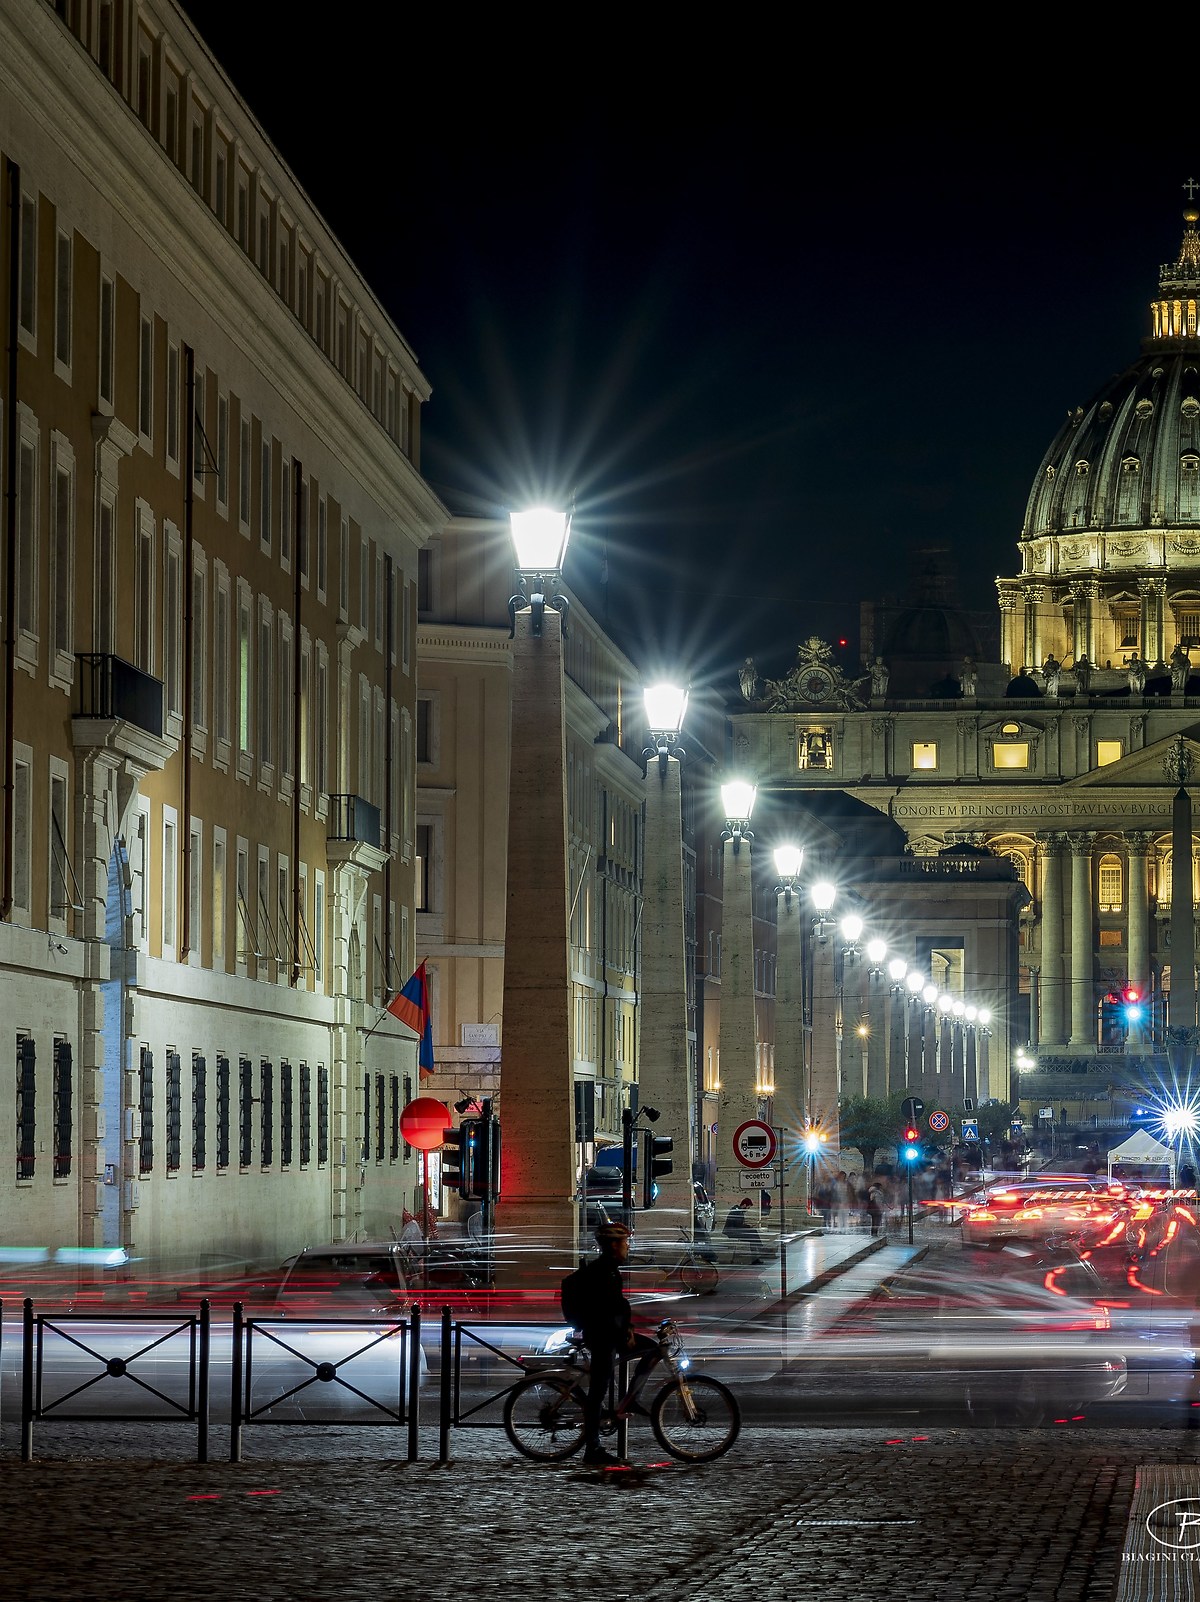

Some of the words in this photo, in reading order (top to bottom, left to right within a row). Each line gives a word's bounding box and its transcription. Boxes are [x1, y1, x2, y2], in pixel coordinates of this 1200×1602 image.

[892, 805, 957, 816] HONOREM
[960, 804, 1028, 816] PRINCIPIS
[1030, 804, 1071, 815] APOST
[1072, 803, 1118, 814] PAVLVS
[749, 1150, 754, 1158] 6
